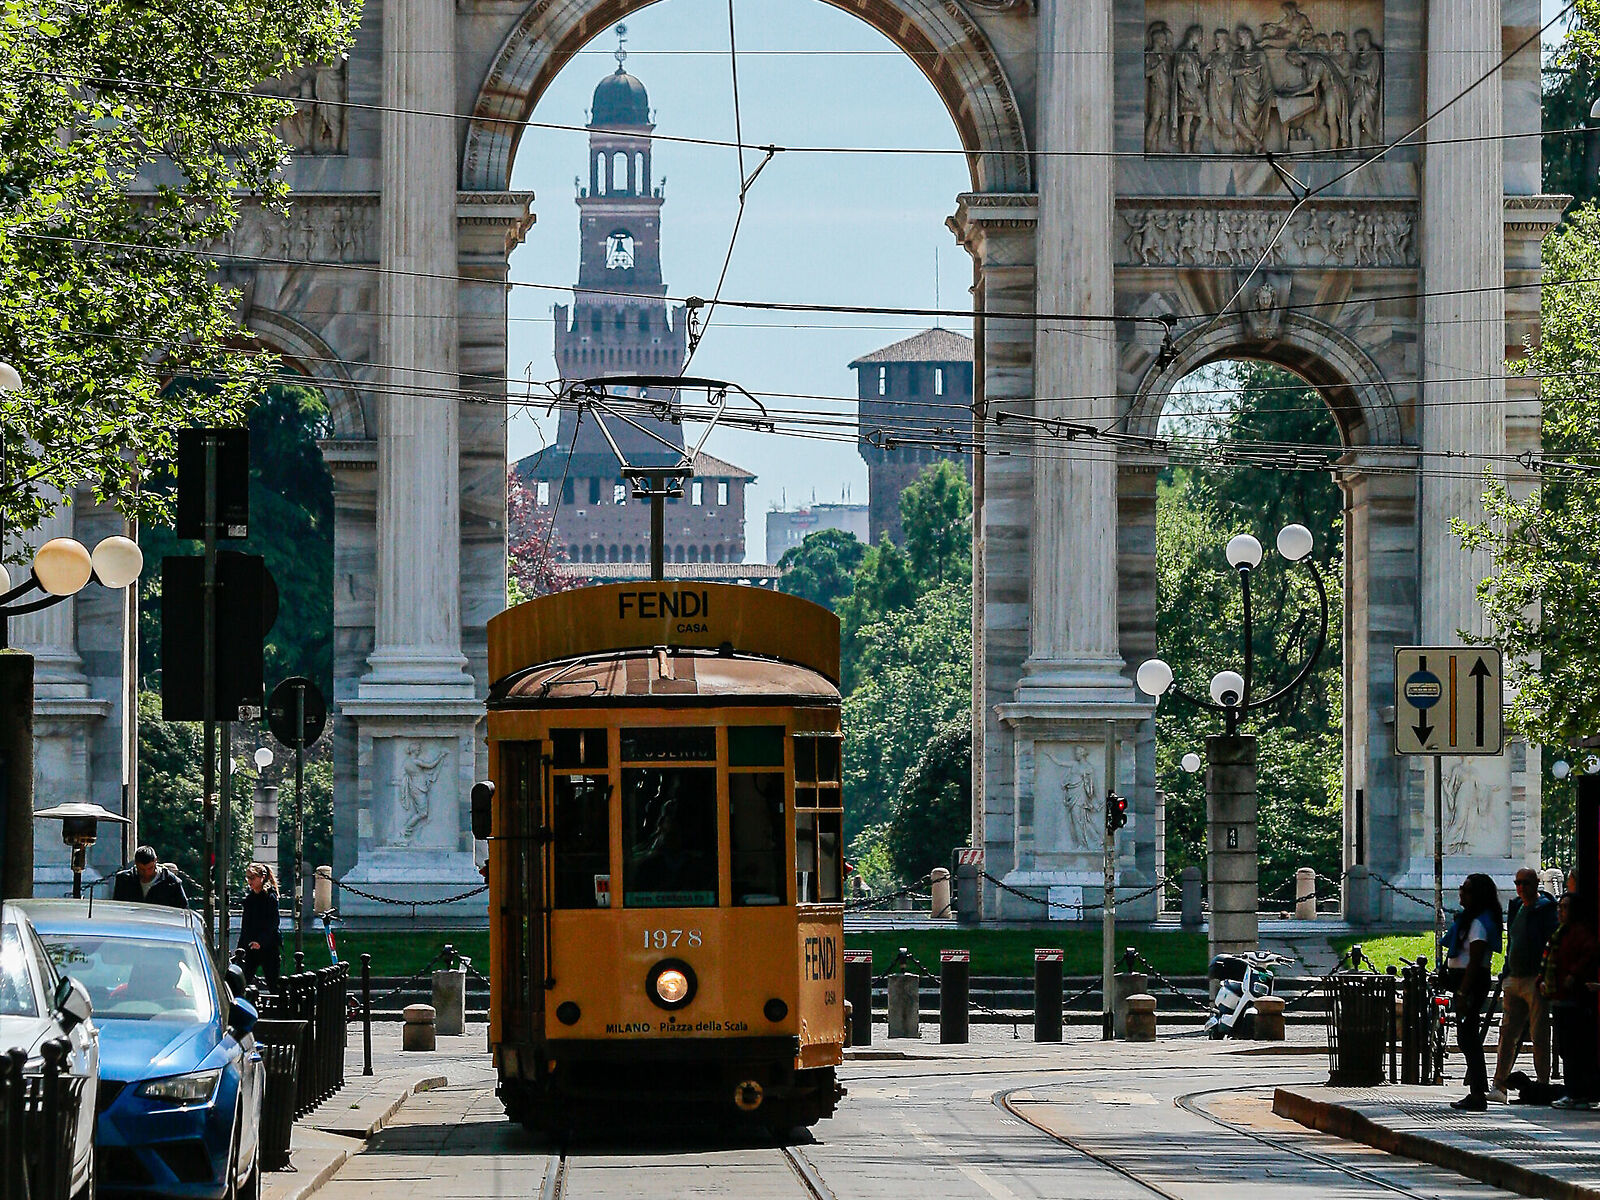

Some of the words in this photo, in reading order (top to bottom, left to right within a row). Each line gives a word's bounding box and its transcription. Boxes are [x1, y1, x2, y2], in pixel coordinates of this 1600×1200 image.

[618, 590, 708, 619] FENDI
[676, 623, 709, 633] CASA
[643, 928, 703, 949] 1978
[804, 935, 837, 981] FENDI
[606, 1022, 651, 1033] MILANO
[660, 1022, 693, 1032] Piazza
[695, 1020, 722, 1031] della
[724, 1020, 748, 1031] Scala
